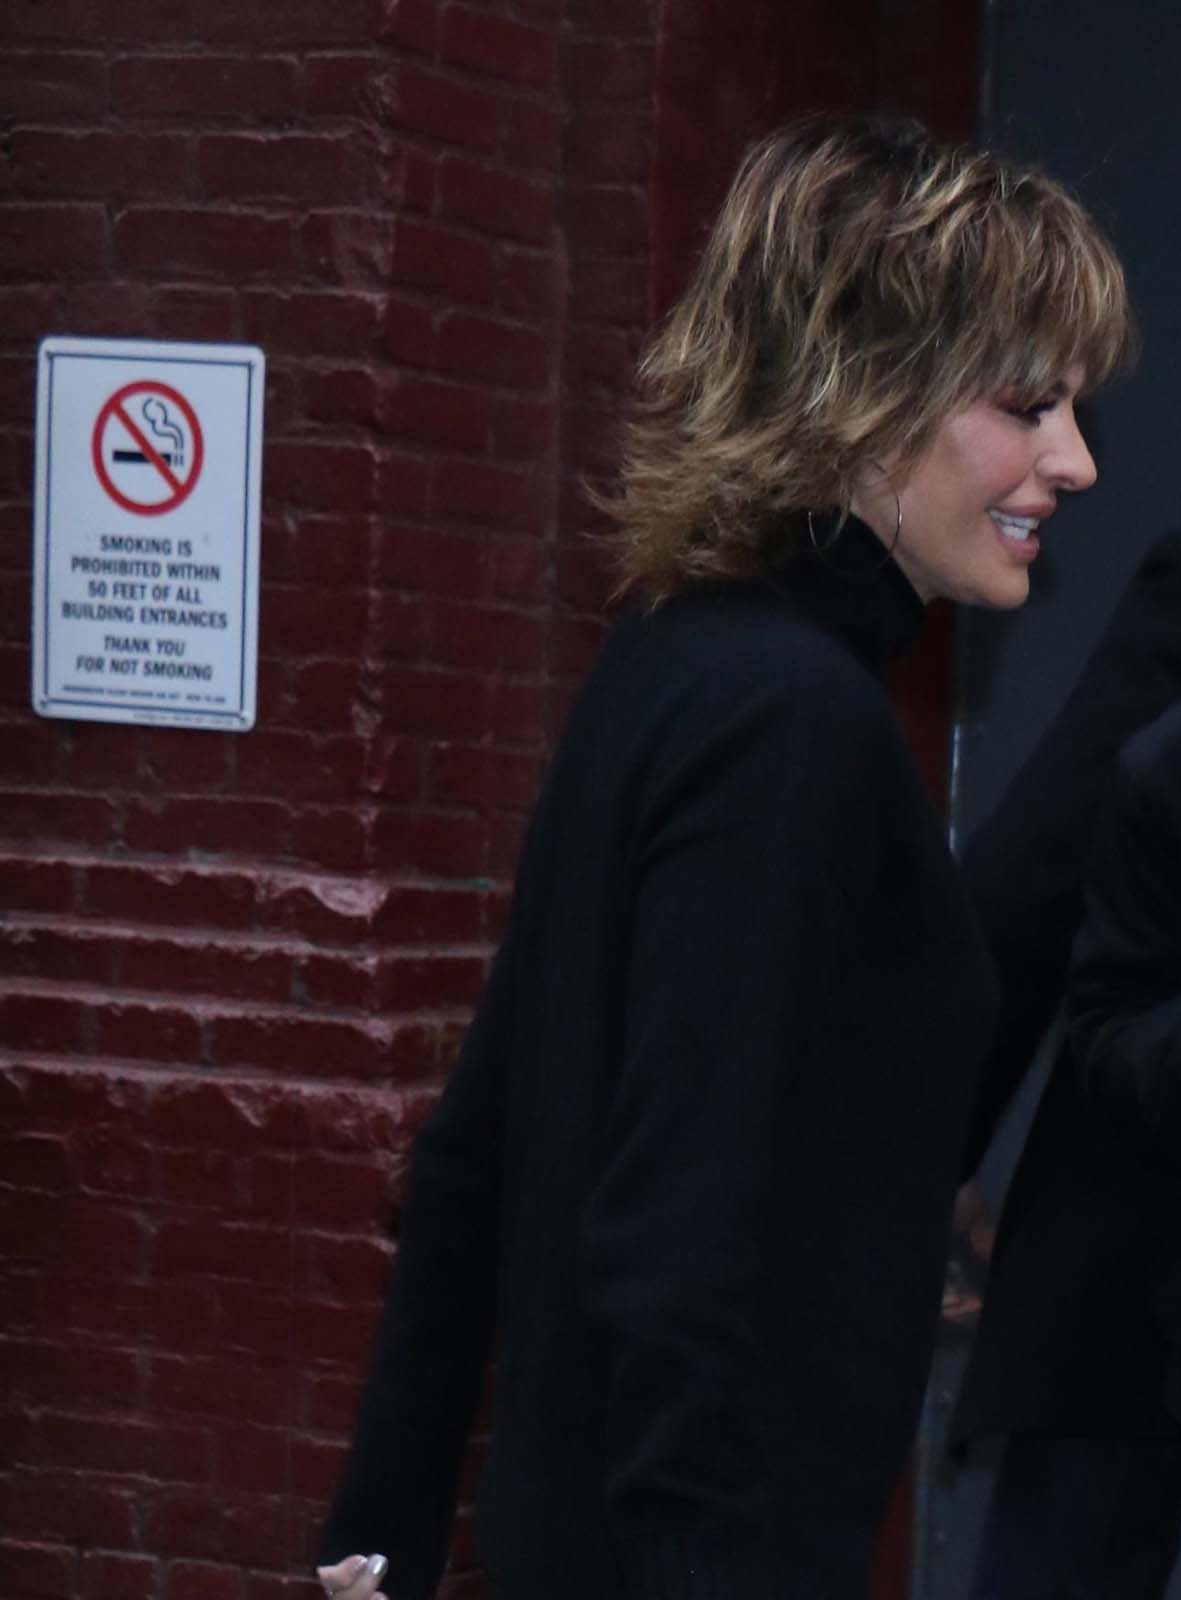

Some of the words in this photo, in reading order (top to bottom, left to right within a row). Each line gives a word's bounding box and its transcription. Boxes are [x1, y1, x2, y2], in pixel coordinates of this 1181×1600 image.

[100, 534, 171, 555] SMOKING
[178, 540, 193, 557] IS
[71, 556, 161, 579] PROHIBITED
[166, 563, 221, 582] WITHIN
[112, 583, 146, 601] FEET
[151, 585, 171, 603] OF
[175, 587, 201, 604] ALL
[61, 601, 135, 623] BUILDING
[140, 608, 228, 630] ENTRANCES
[103, 635, 151, 654] THANK
[156, 639, 187, 656] YOU
[75, 655, 104, 672] FOR
[108, 658, 138, 676] NOT
[143, 662, 213, 681] SMOKING
